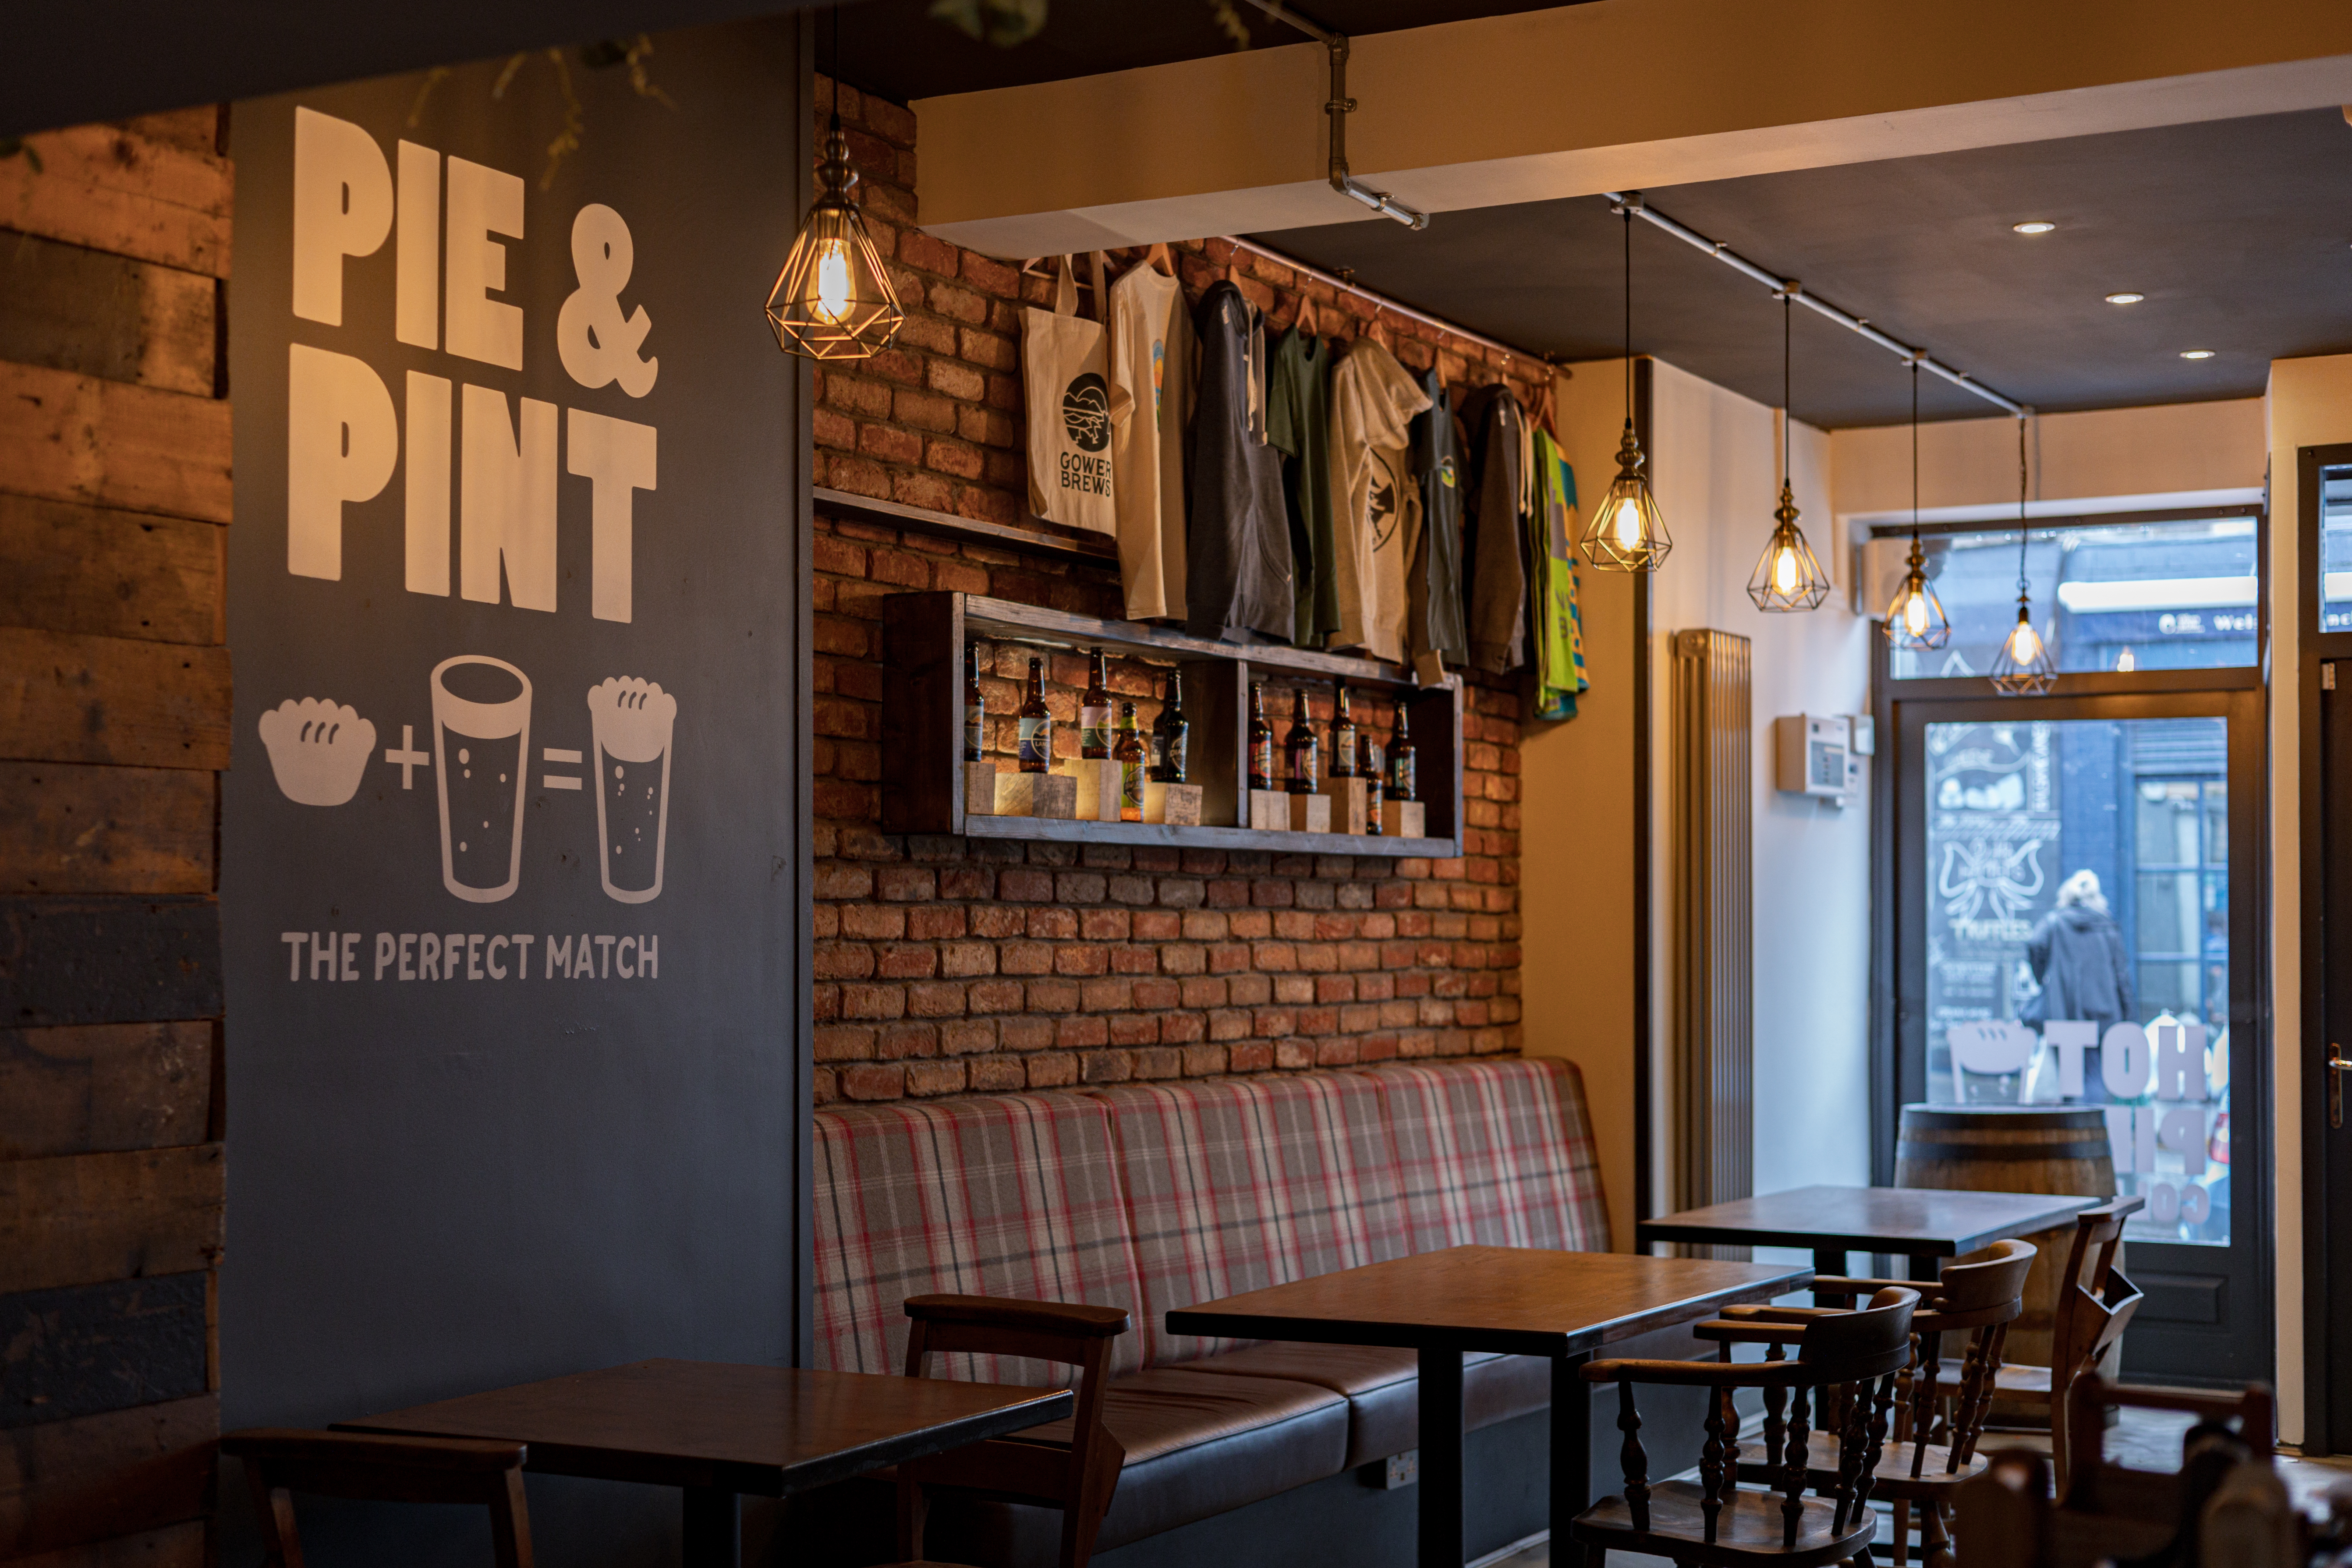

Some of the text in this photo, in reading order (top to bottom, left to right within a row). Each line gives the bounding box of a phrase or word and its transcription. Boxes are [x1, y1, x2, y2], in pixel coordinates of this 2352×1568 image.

[291, 105, 658, 399] PIE &
[287, 342, 658, 624] PINT
[1060, 452, 1111, 479] GOWER
[1061, 471, 1111, 497] BREWS
[281, 931, 659, 981] THE PERFECT MATCH
